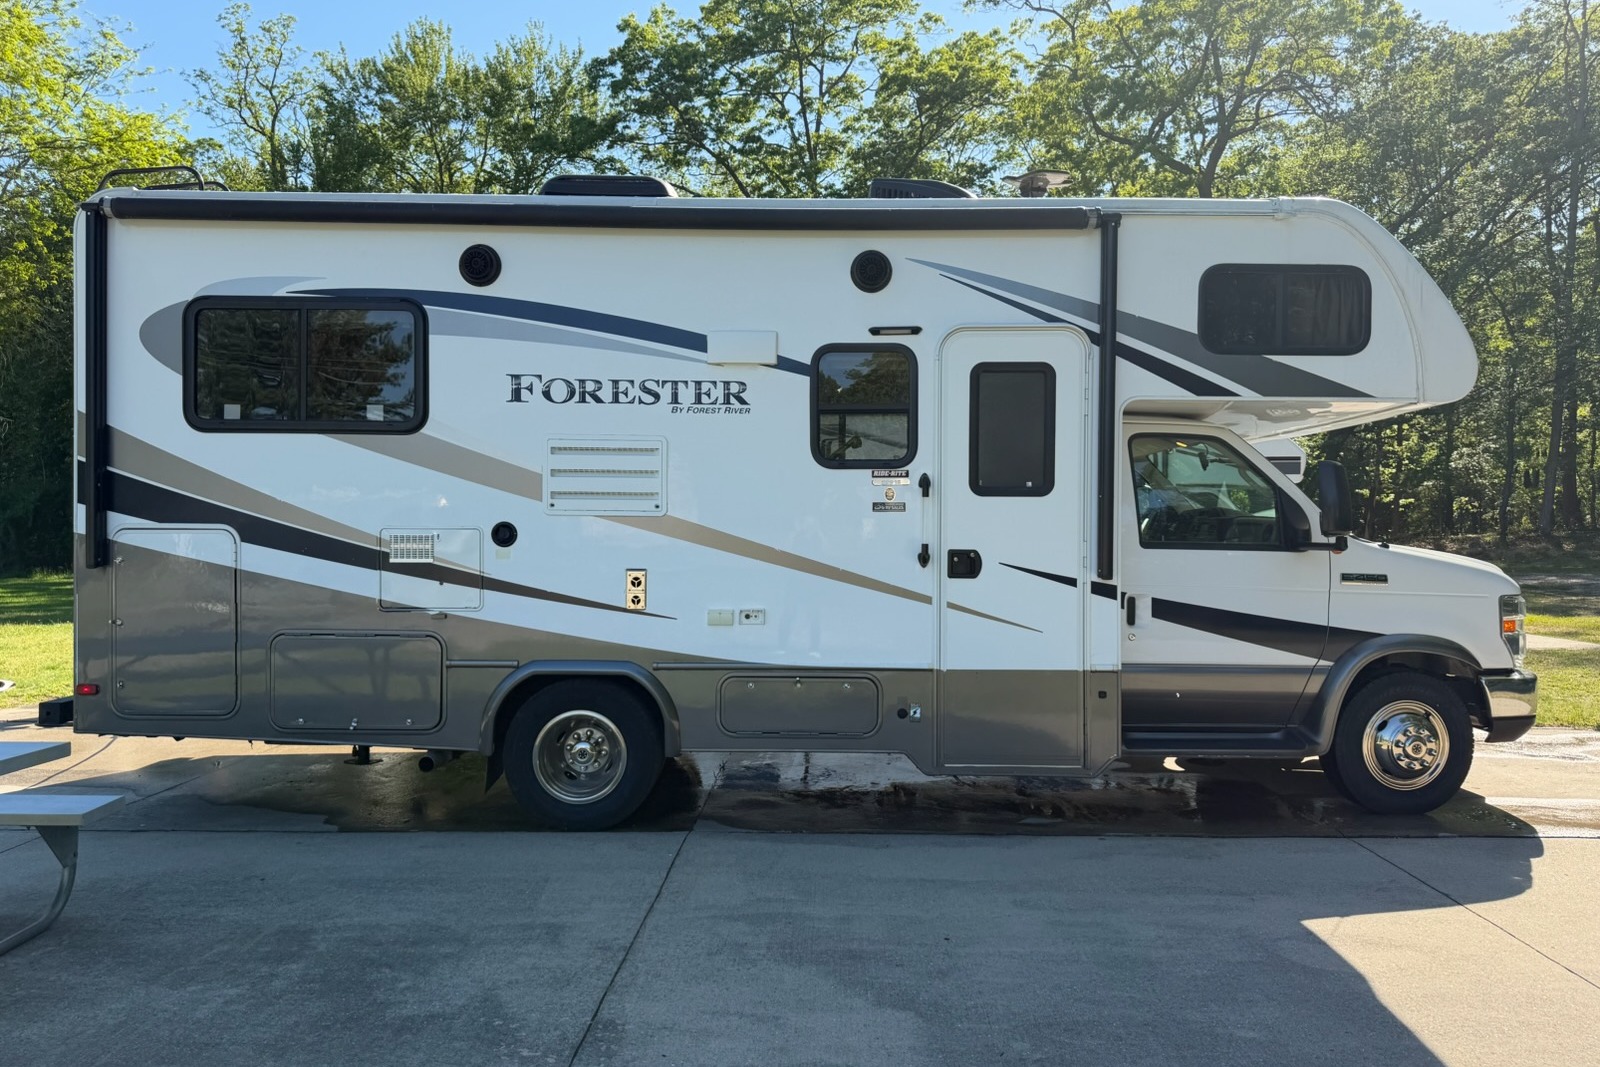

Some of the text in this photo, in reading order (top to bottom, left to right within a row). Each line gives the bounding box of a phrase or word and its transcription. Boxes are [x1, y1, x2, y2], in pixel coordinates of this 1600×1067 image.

[506, 373, 751, 406] FORESTER
[671, 405, 751, 415] BY FOREST RIVER
